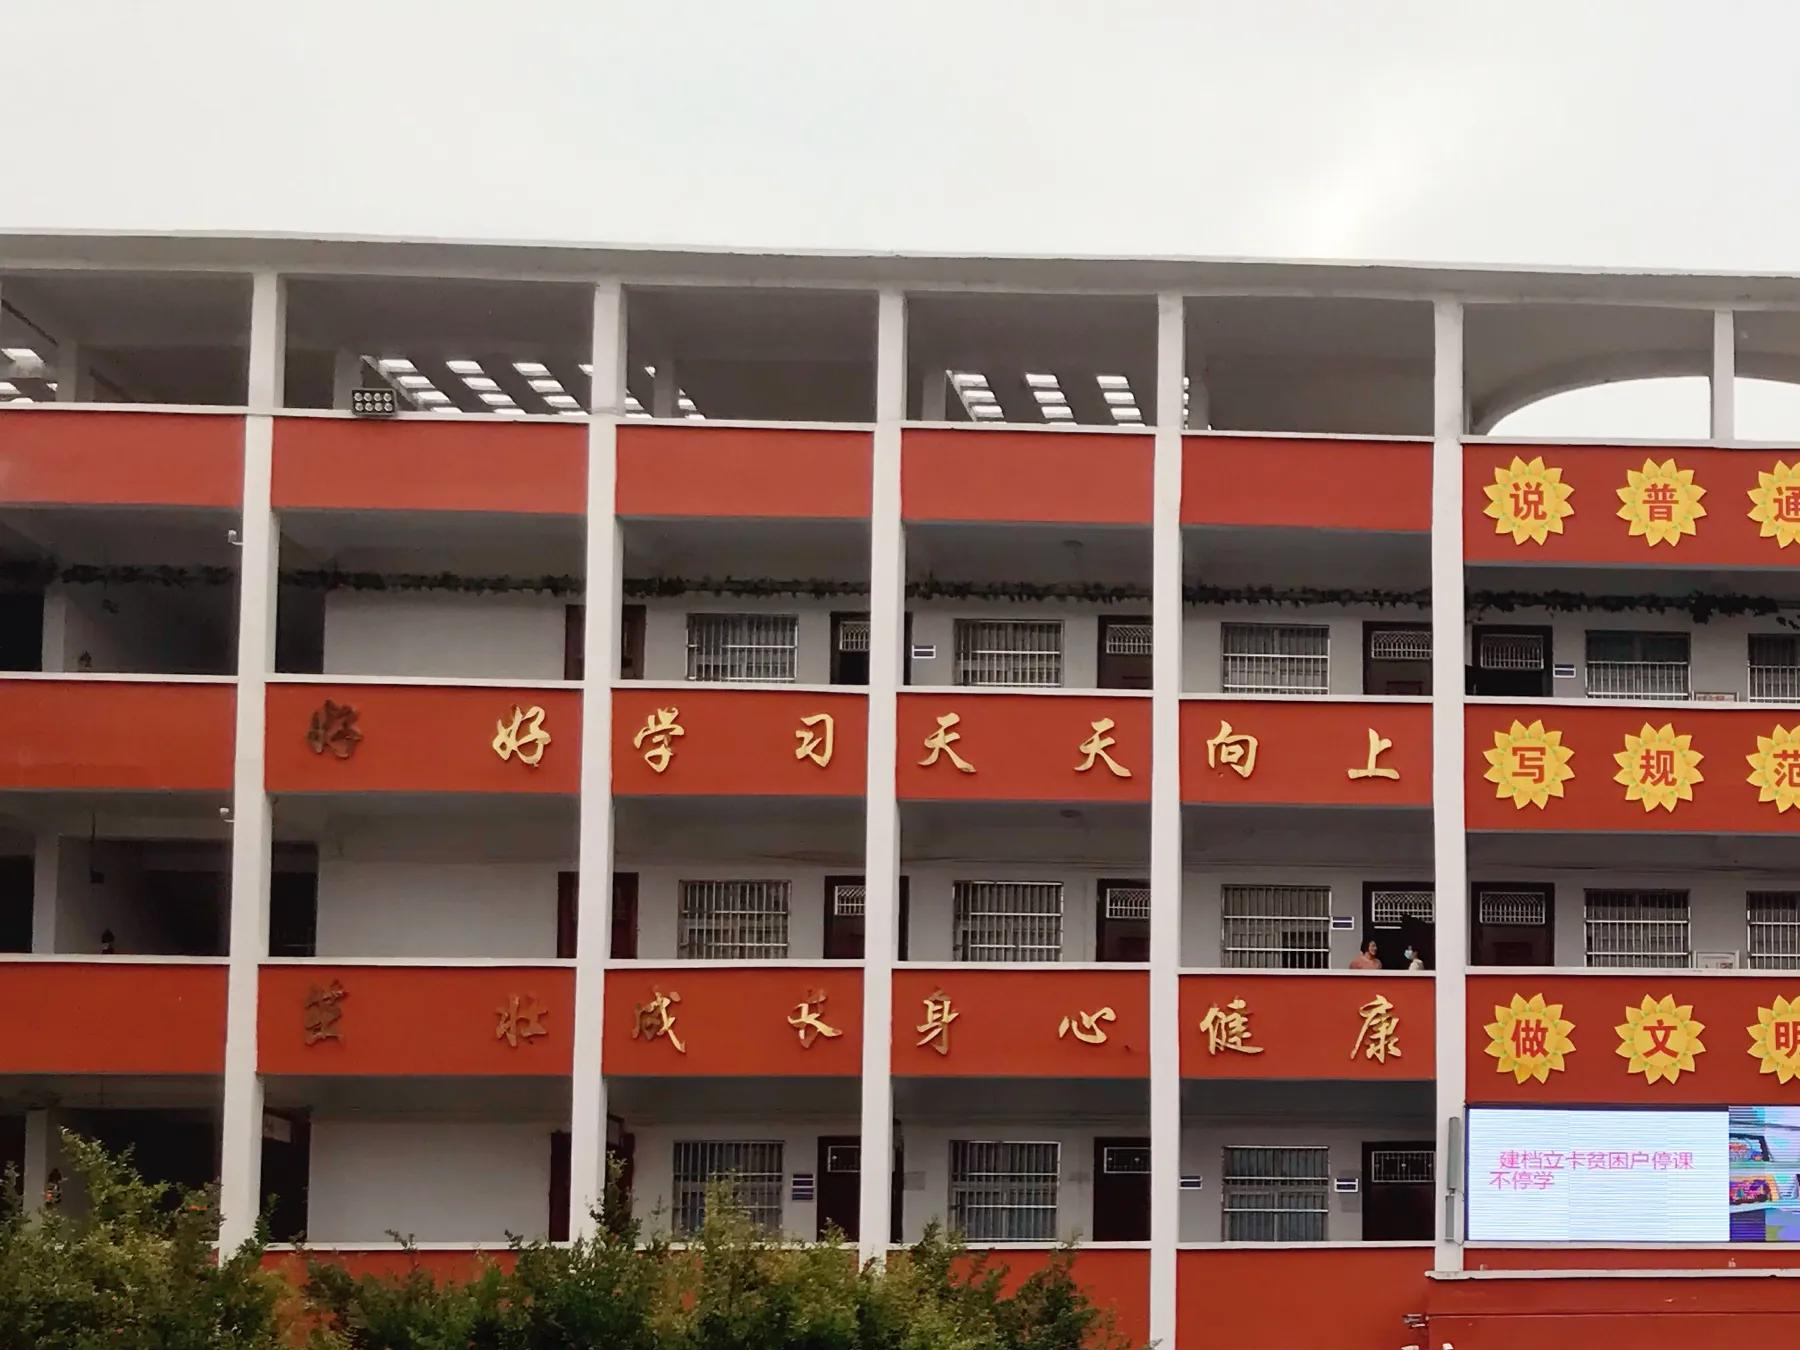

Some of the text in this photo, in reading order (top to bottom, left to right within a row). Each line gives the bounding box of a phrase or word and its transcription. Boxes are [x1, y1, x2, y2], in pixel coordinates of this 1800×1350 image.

[1499, 1151, 1695, 1170] 建档立卡贫困户停课
[1489, 1171, 1555, 1190] 不停学
